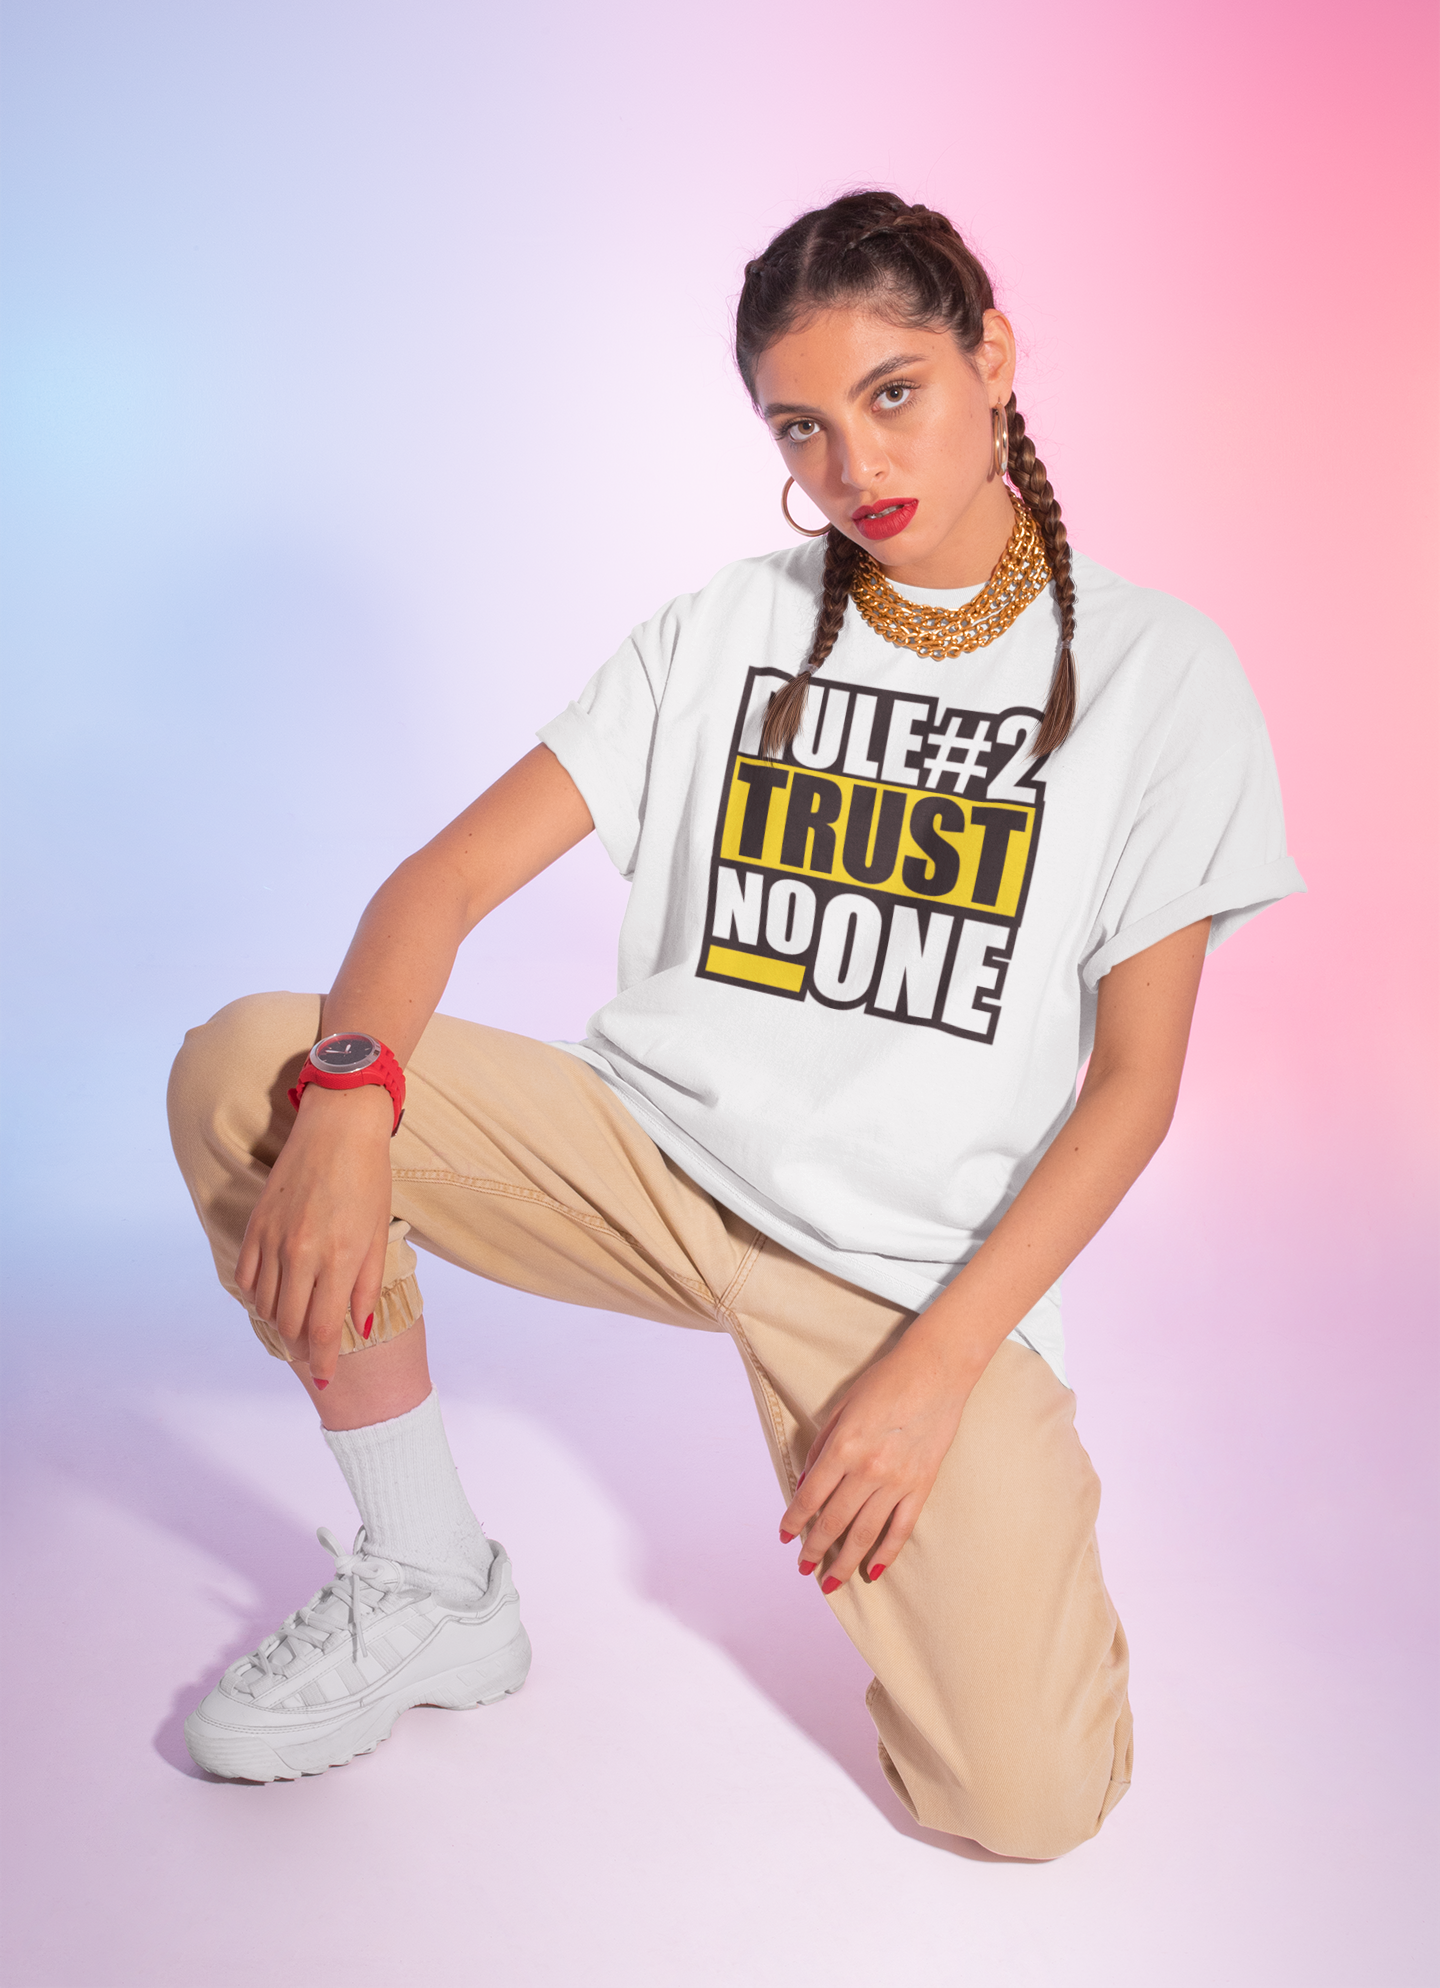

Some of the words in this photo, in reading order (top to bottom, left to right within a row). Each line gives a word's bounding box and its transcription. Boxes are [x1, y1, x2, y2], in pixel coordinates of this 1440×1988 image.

[737, 762, 1028, 907] TRUST
[712, 866, 816, 955] NO
[813, 893, 1010, 1035] ONE
